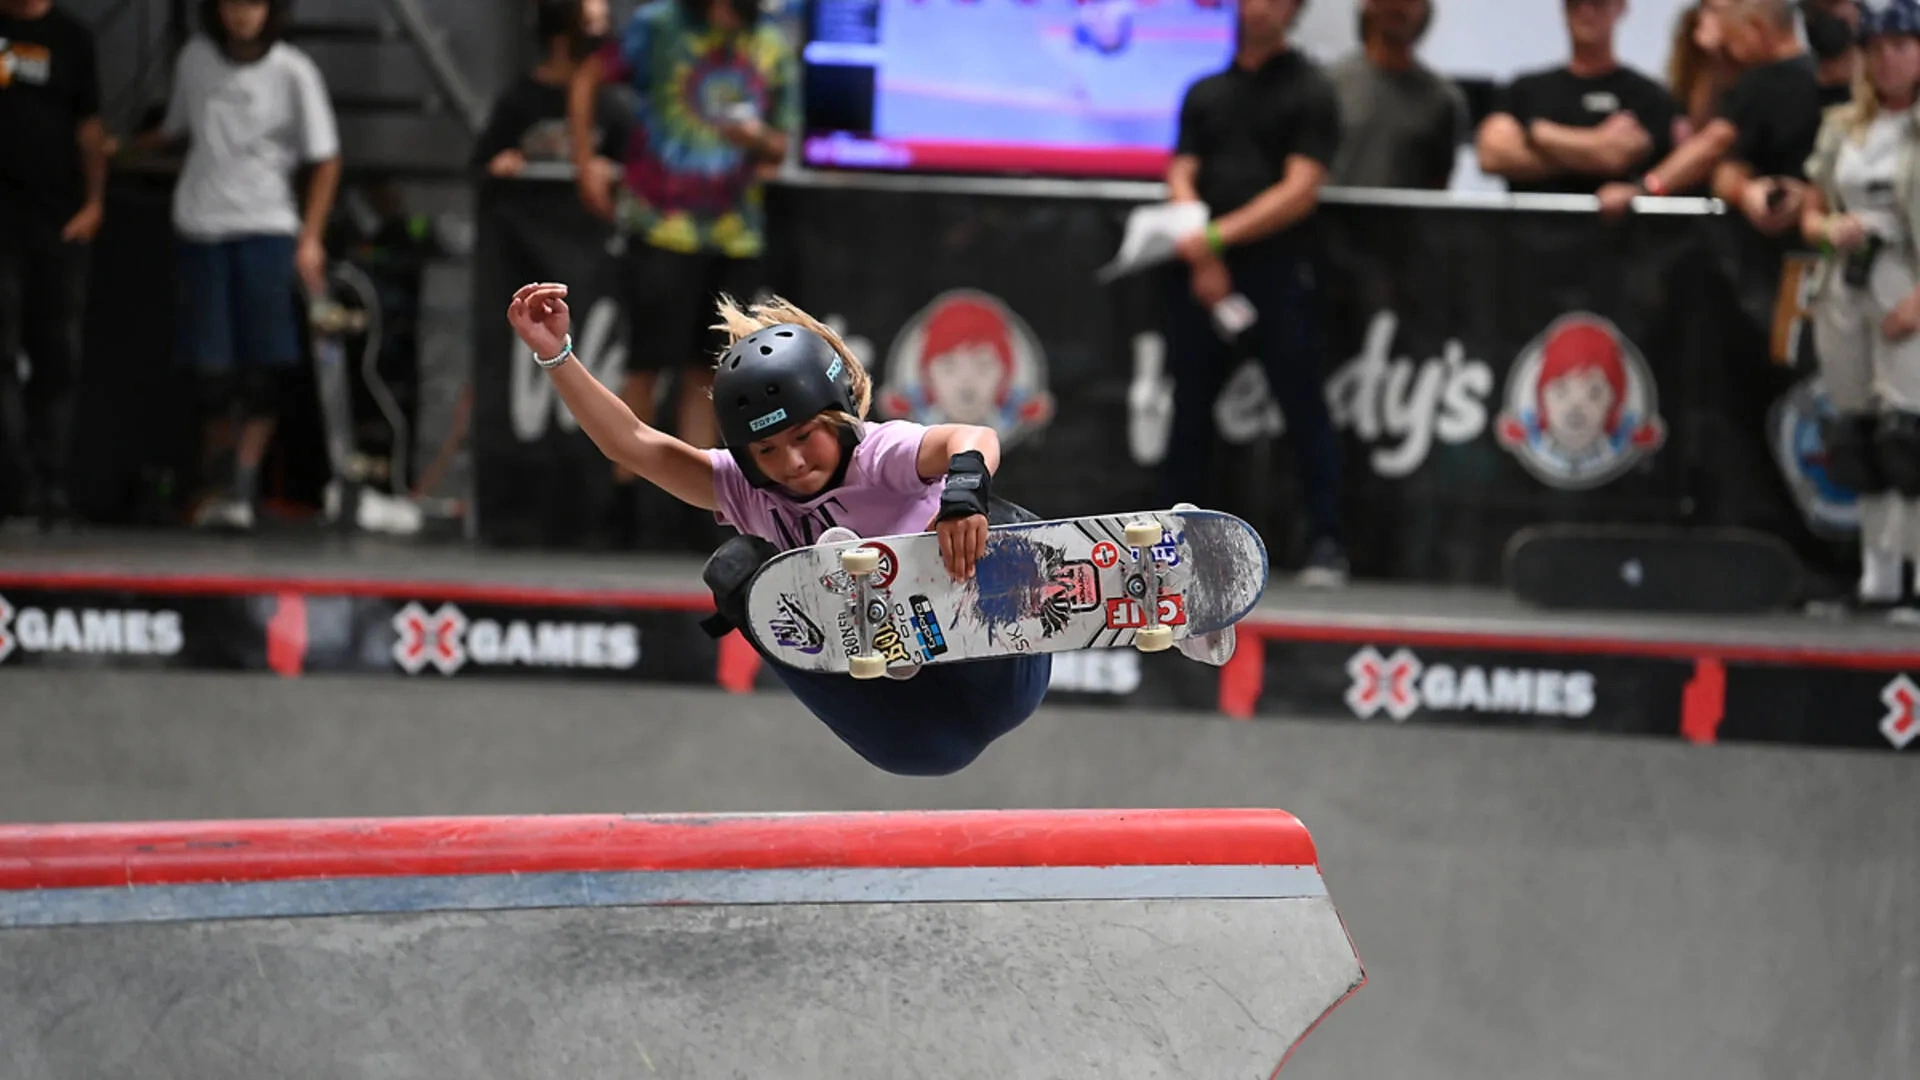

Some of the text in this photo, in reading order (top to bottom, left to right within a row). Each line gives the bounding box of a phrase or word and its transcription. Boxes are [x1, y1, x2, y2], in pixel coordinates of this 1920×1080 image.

[15, 606, 184, 657] GAMES
[1112, 599, 1178, 626] CIF
[467, 618, 640, 670] GAMES
[1420, 665, 1596, 717] GAMES
